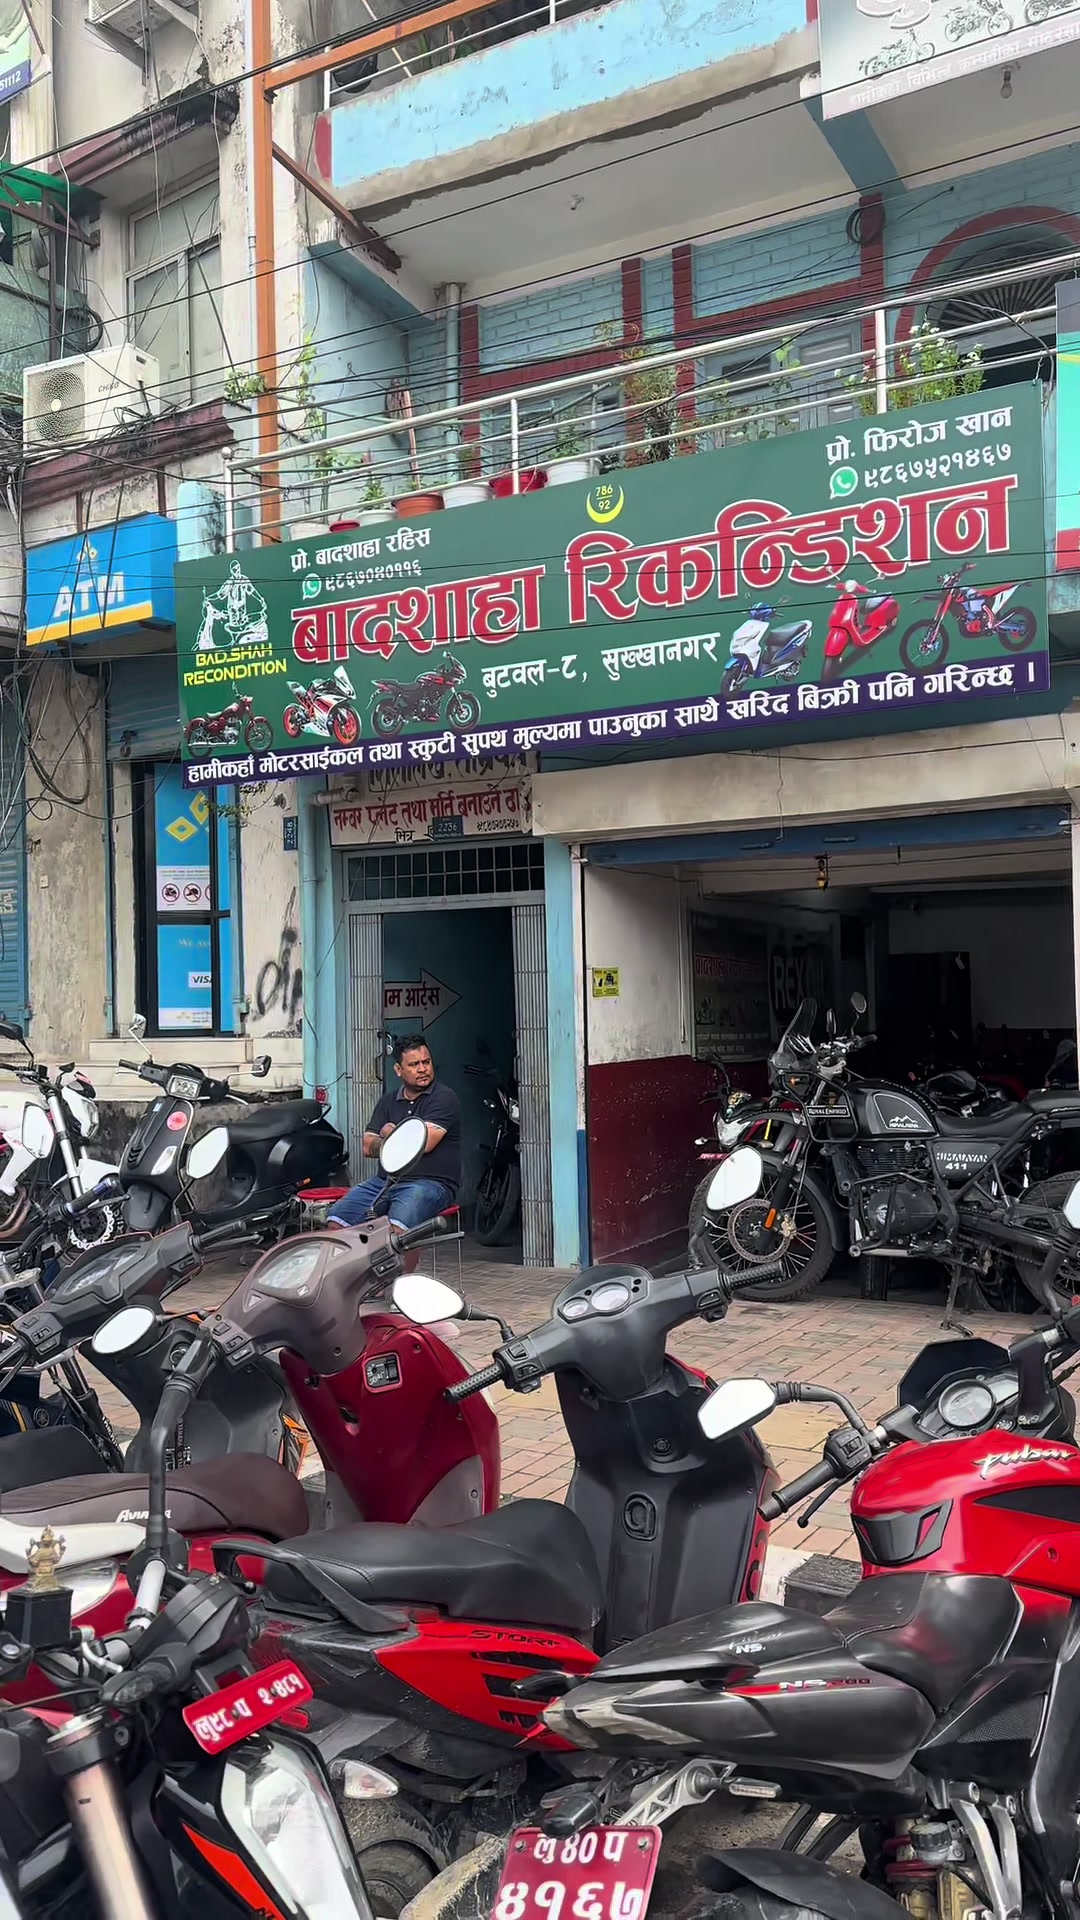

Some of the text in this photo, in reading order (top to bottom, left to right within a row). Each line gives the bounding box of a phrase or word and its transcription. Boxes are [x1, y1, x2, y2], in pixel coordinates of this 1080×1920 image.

[825, 406, 1013, 466] प्रो. फिरोज खान
[864, 443, 1012, 488] ९८६७५२१४६७
[595, 484, 613, 497] 786
[598, 500, 611, 511] 92
[290, 526, 431, 572] प्रो. बादशाहा रहिस
[291, 473, 1019, 664] बादशाहा रिकन्डिशन
[324, 559, 422, 592] ९८६७०४०११६
[53, 572, 125, 618] ATM
[196, 642, 273, 667] BADSHAH
[601, 632, 721, 681] सुख्खानगर
[183, 658, 287, 687] RECONDITION
[188, 755, 254, 783] हामीकहाँ
[259, 746, 363, 775] मोटरसाईकल
[369, 741, 402, 763] तथा
[407, 730, 456, 762] स्कुटी
[461, 729, 508, 756] सुपथ
[513, 720, 582, 750] मुल्यमा
[588, 709, 668, 737] पाउनुका
[674, 697, 719, 727] साथै
[726, 690, 790, 720] खरिद
[798, 680, 860, 712] बिक्री
[868, 672, 914, 702] पनि
[923, 663, 1015, 695] गरिन्छ
[400, 800, 428, 828] तथा
[945, 1162, 968, 1170] 411
[736, 1643, 765, 1654] NS
[602, 1831, 629, 1862] प
